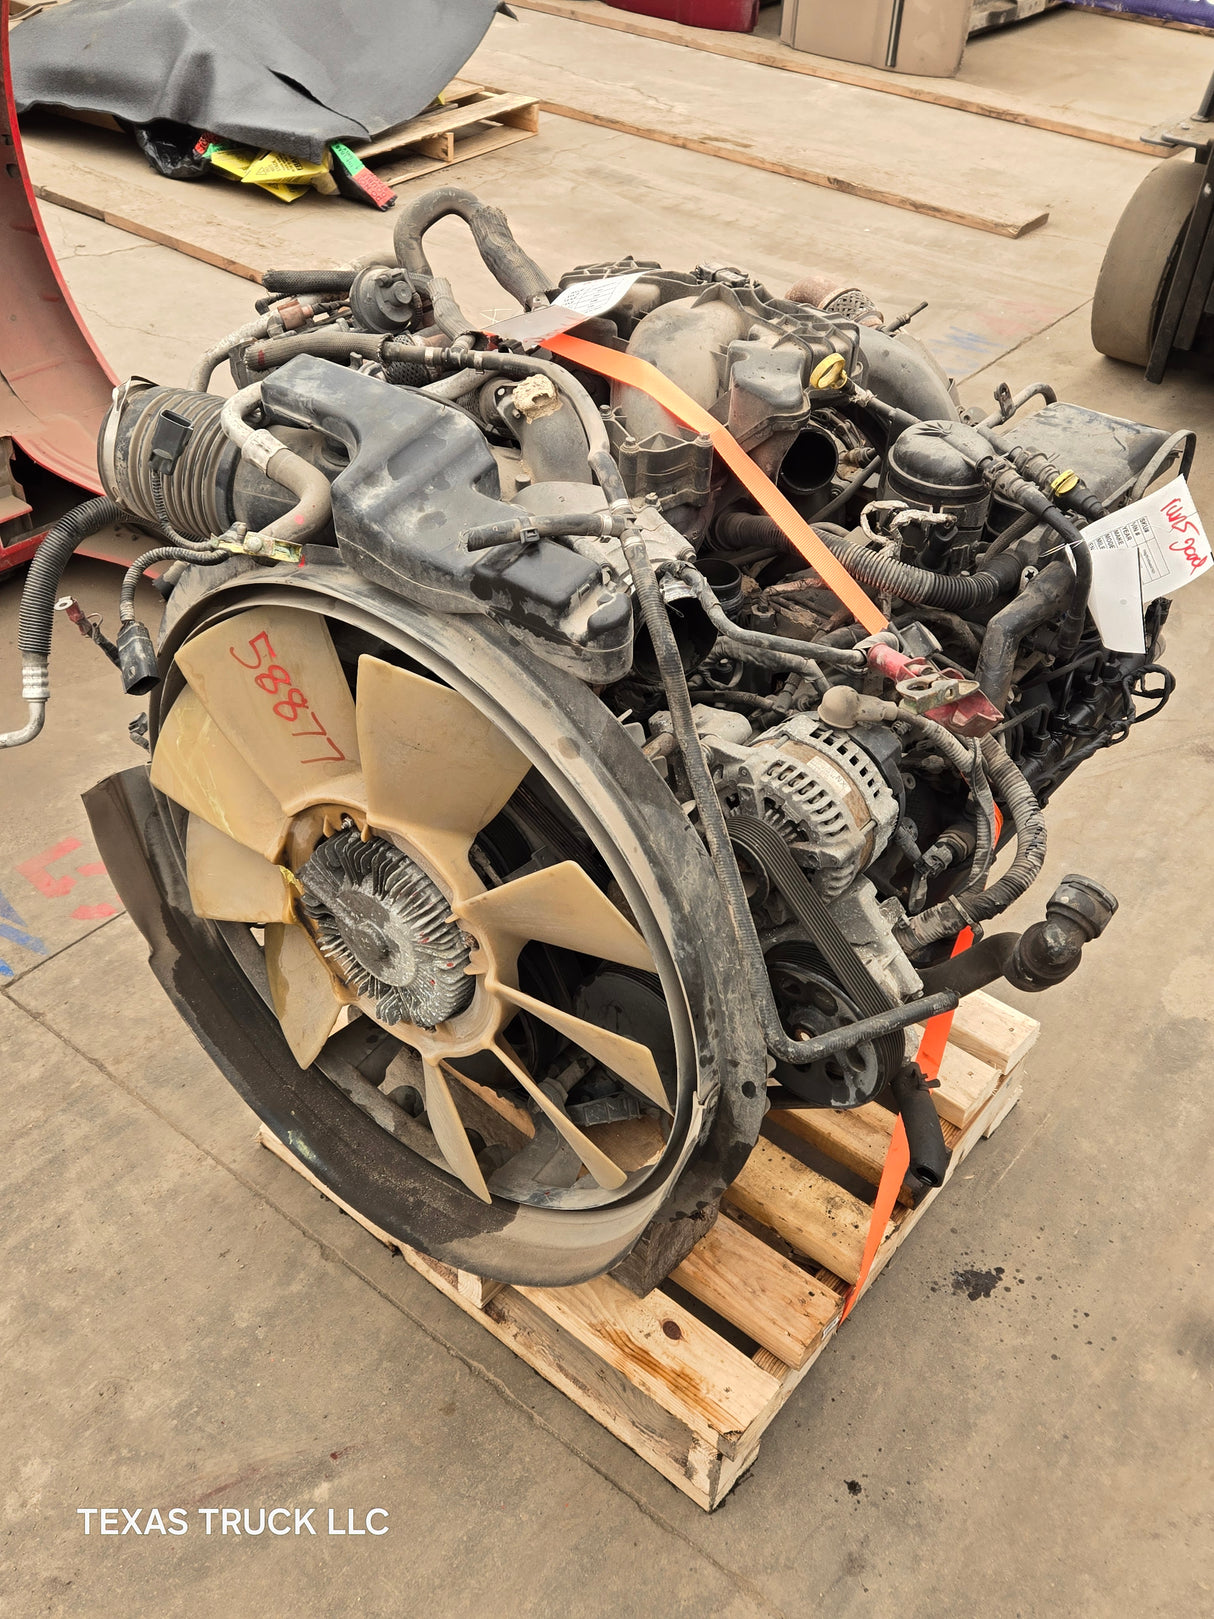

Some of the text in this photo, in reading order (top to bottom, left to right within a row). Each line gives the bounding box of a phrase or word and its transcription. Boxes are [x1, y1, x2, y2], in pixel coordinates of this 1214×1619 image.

[1122, 525, 1133, 541] YEAR
[1131, 521, 1139, 532] VIN
[1114, 529, 1124, 546] MAKE
[229, 630, 346, 764] 58877
